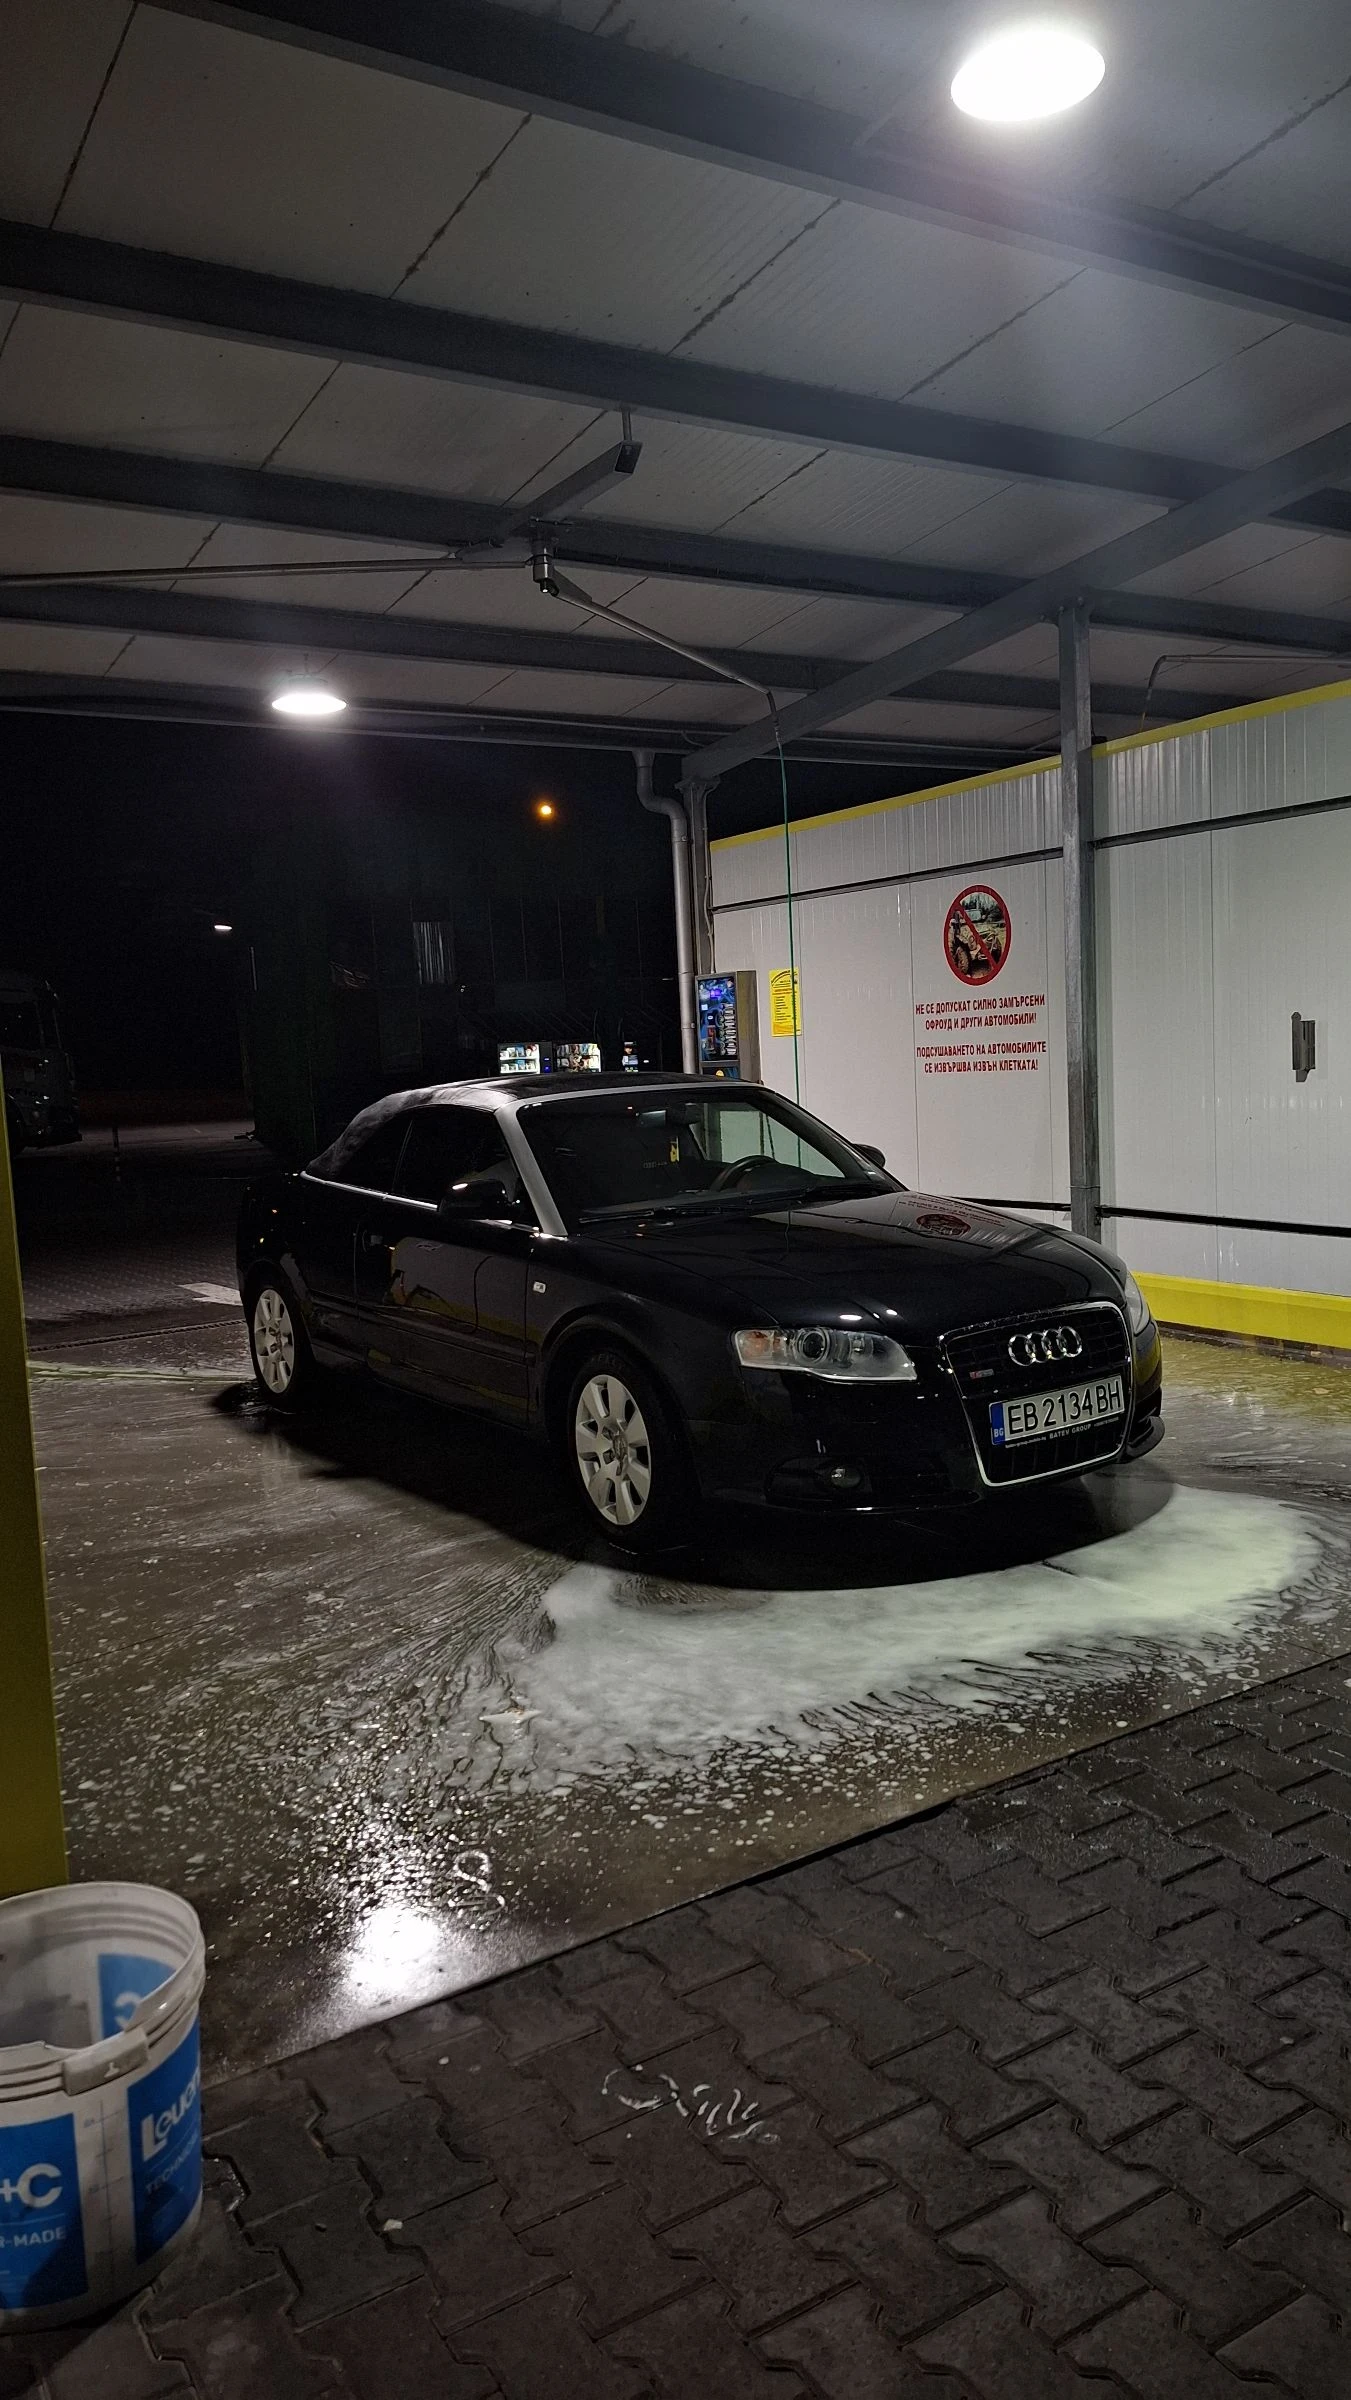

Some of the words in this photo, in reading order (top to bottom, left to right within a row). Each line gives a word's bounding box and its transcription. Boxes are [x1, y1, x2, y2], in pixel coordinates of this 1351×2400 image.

[916, 1004, 924, 1015] НЕ
[926, 1003, 934, 1013] СЕ
[936, 1000, 971, 1015] ДОПУСКАТ
[973, 998, 997, 1010] СИЛНО
[999, 994, 1045, 1008] ЗАМЪРСЕНИ
[925, 1018, 953, 1031] ОФРОУД
[954, 1018, 959, 1028] И
[960, 1016, 982, 1029] ДРУГИ
[984, 1013, 1037, 1027] АВТОМОБИЛИ!
[917, 1045, 974, 1059] ПОДСУШАВАНЕТО
[976, 1044, 986, 1055] НА
[988, 1041, 1046, 1054] АВТОМОБИЛИТЕ
[925, 1062, 933, 1073] СЕ
[934, 1061, 971, 1073] ИЗВЪРШВА
[973, 1060, 998, 1072] ИЗВЪН
[999, 1059, 1039, 1071] КЛЕТКАТА!
[1042, 1388, 1093, 1427] 2134
[994, 1428, 1004, 1438] BG
[1071, 1423, 1092, 1433] GROUP
